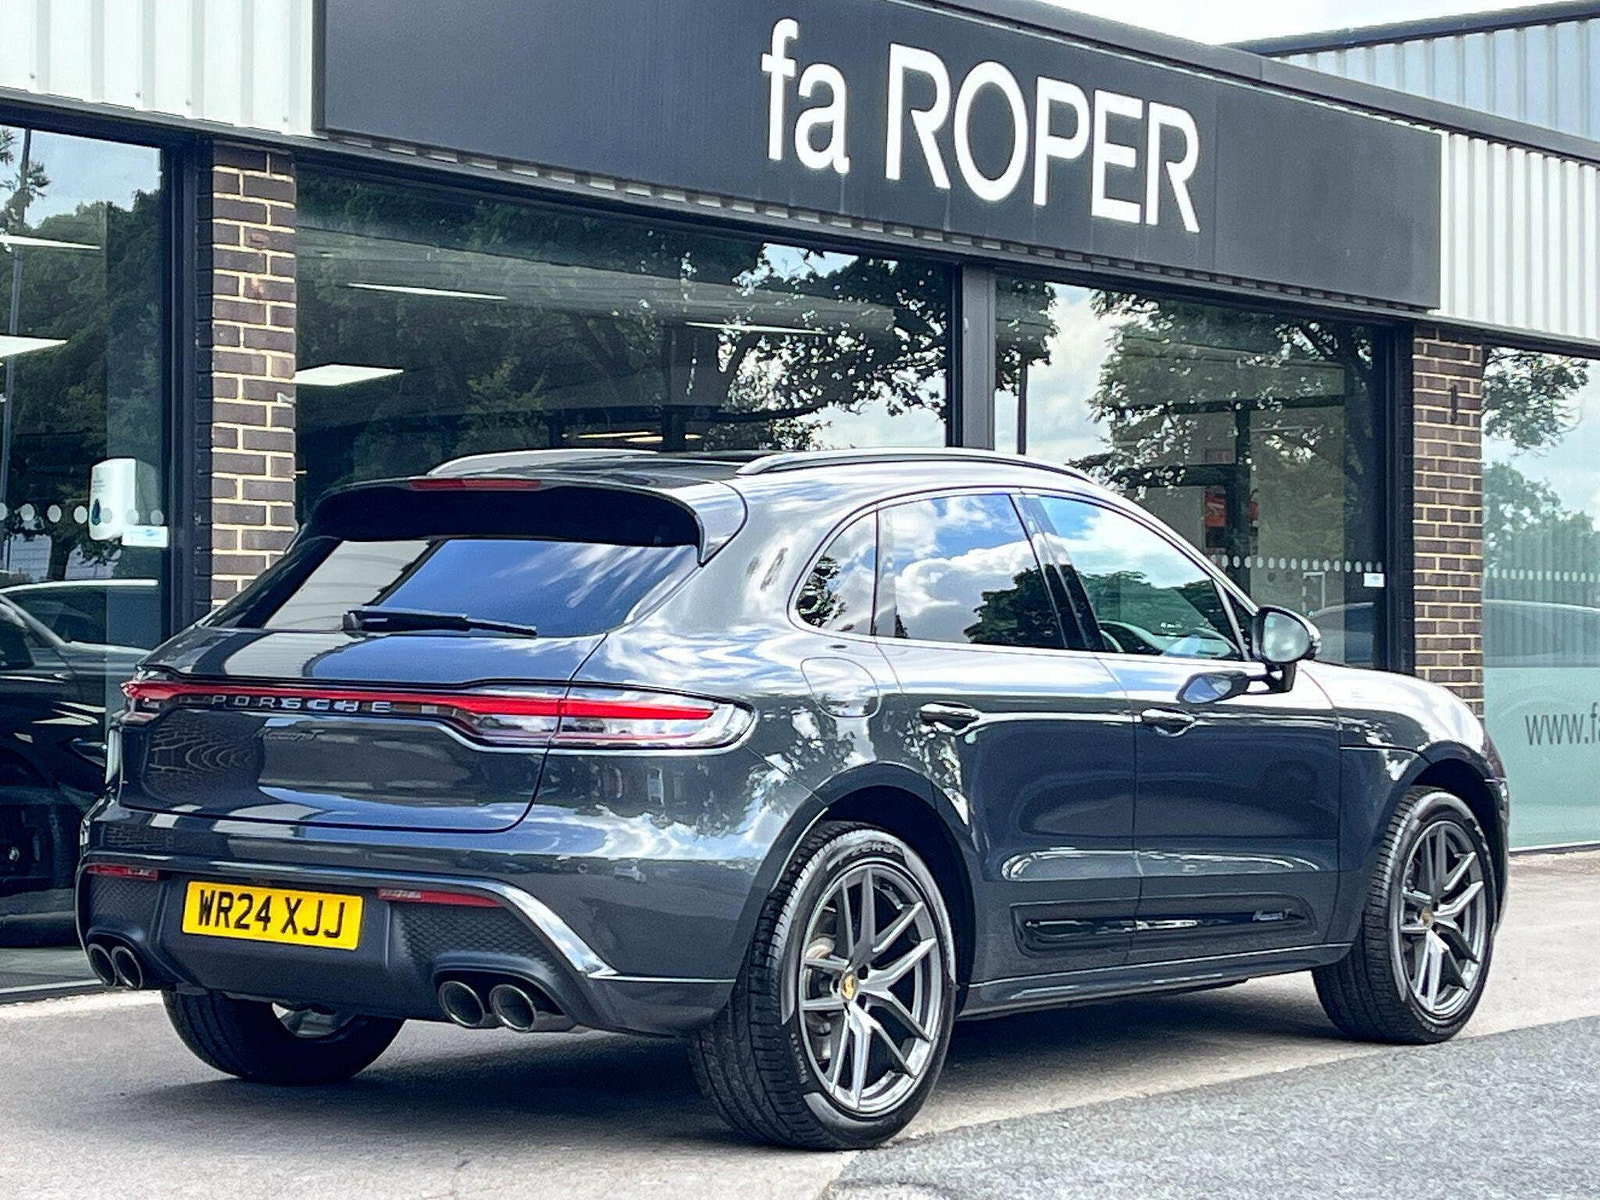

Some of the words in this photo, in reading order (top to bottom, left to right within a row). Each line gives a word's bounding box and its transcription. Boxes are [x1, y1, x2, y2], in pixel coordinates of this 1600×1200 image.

[761, 18, 850, 174] fa
[885, 43, 1200, 233] ROPER
[211, 694, 391, 713] PORSCHE
[1525, 702, 1600, 746] www.f
[198, 889, 271, 932] WR24
[280, 897, 346, 938] XJJ
